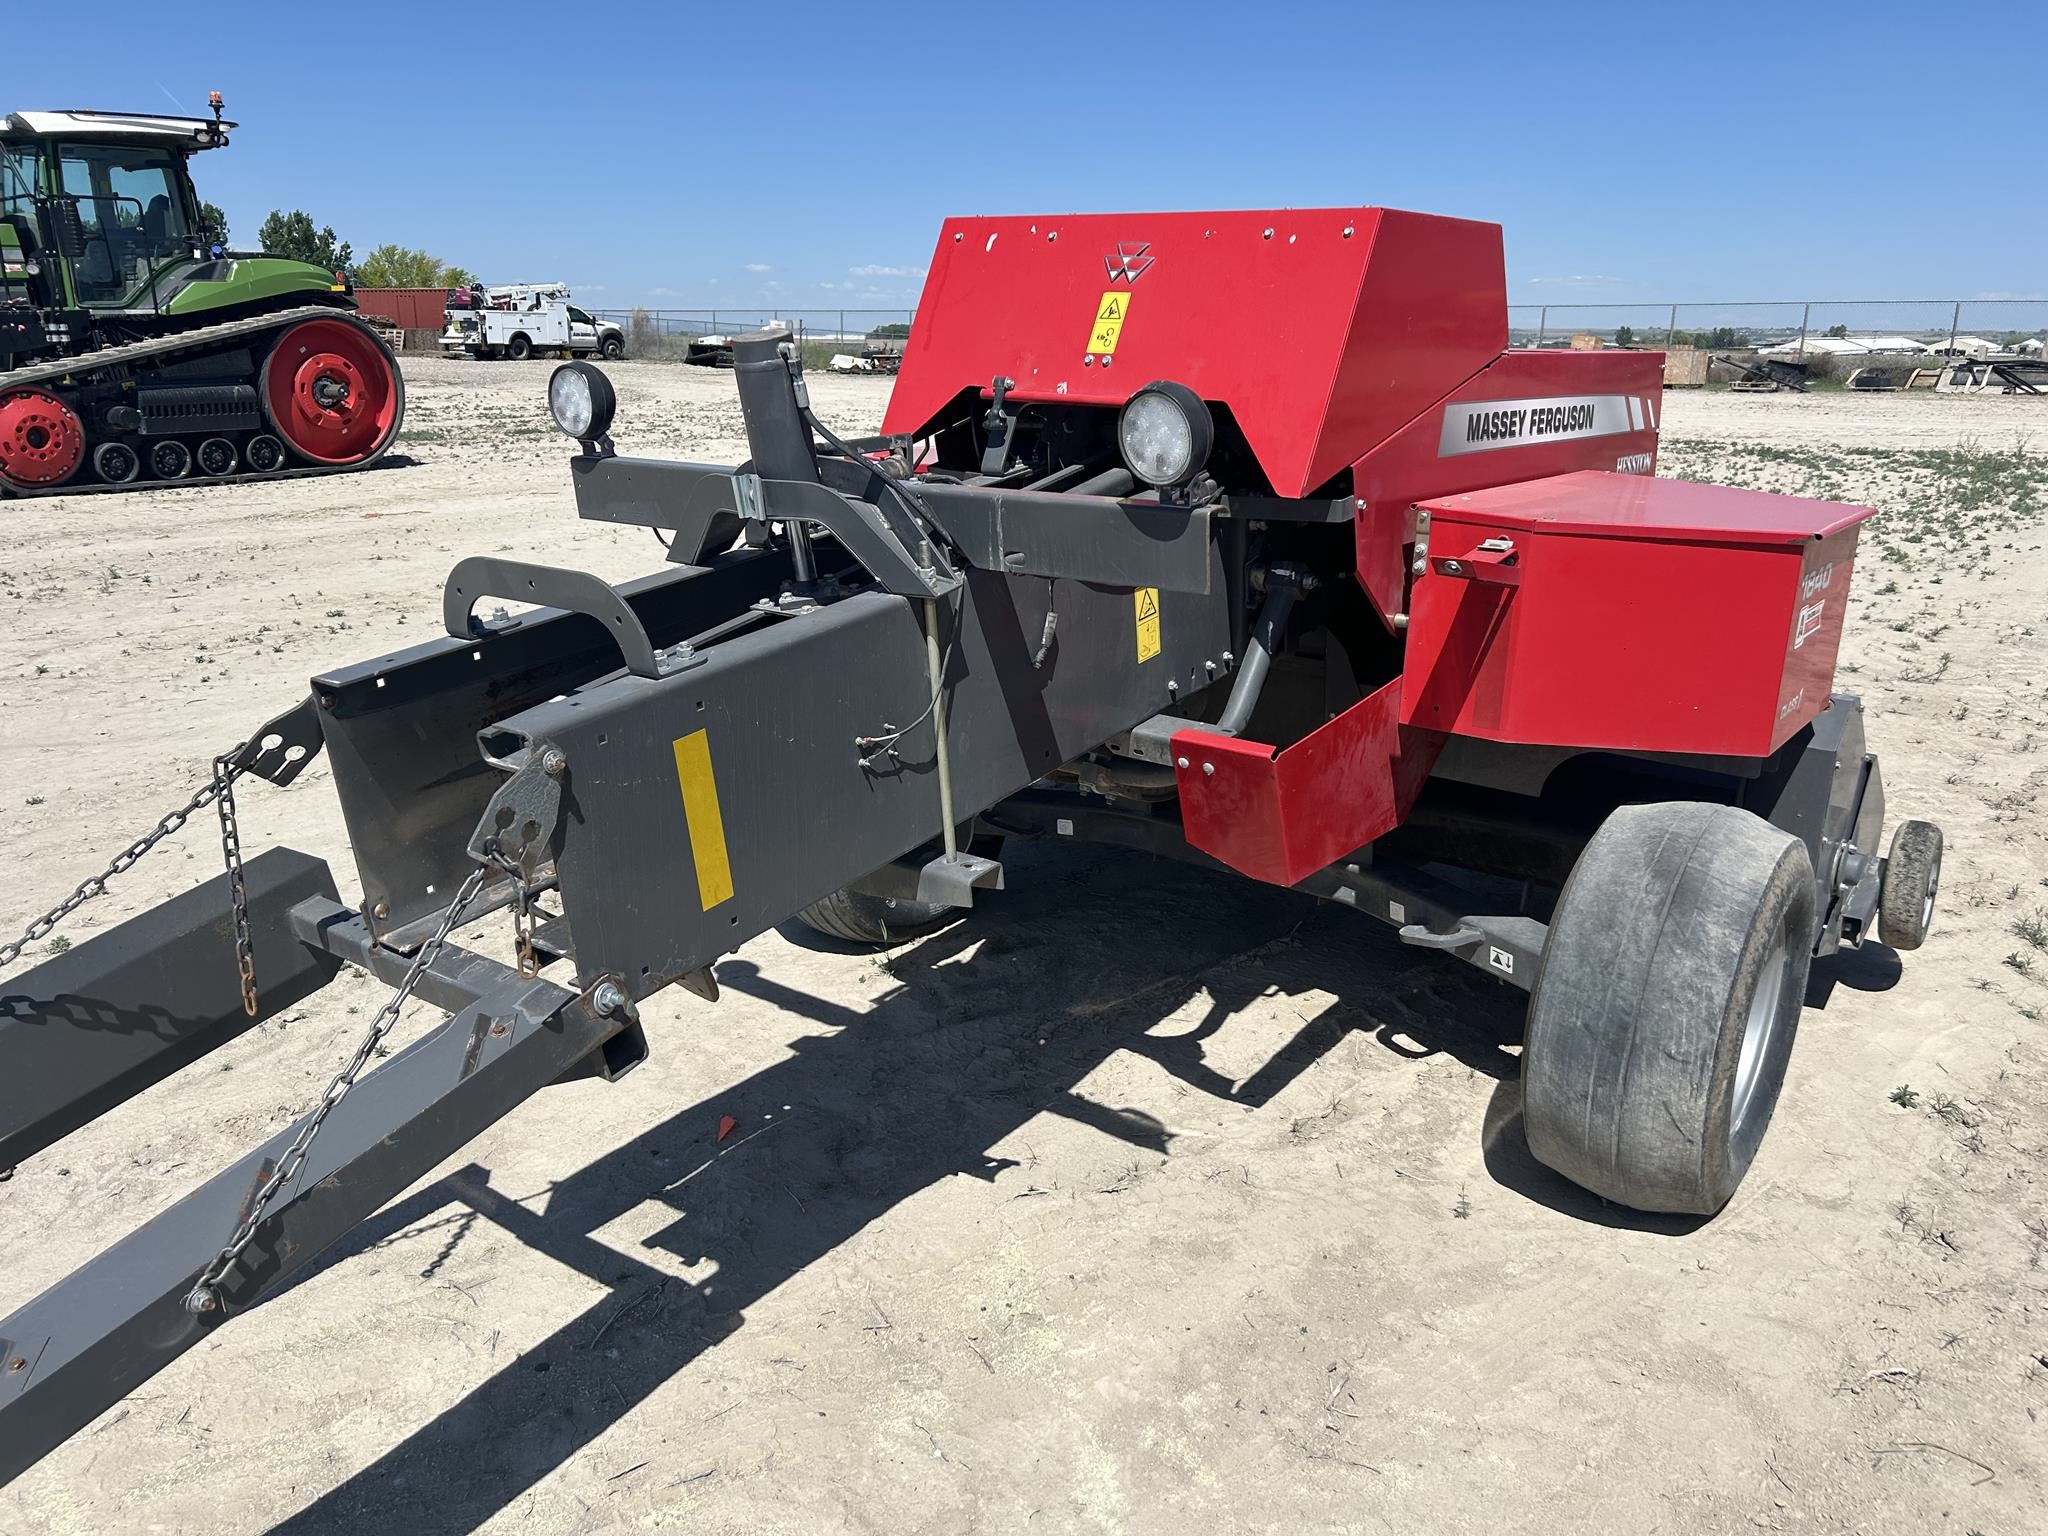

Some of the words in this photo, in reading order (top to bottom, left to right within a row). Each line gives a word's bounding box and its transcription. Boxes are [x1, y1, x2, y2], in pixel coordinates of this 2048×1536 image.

[1467, 409, 1527, 443] MASSEY
[1529, 404, 1595, 436] FERGUSON
[1802, 562, 1833, 600] 1840
